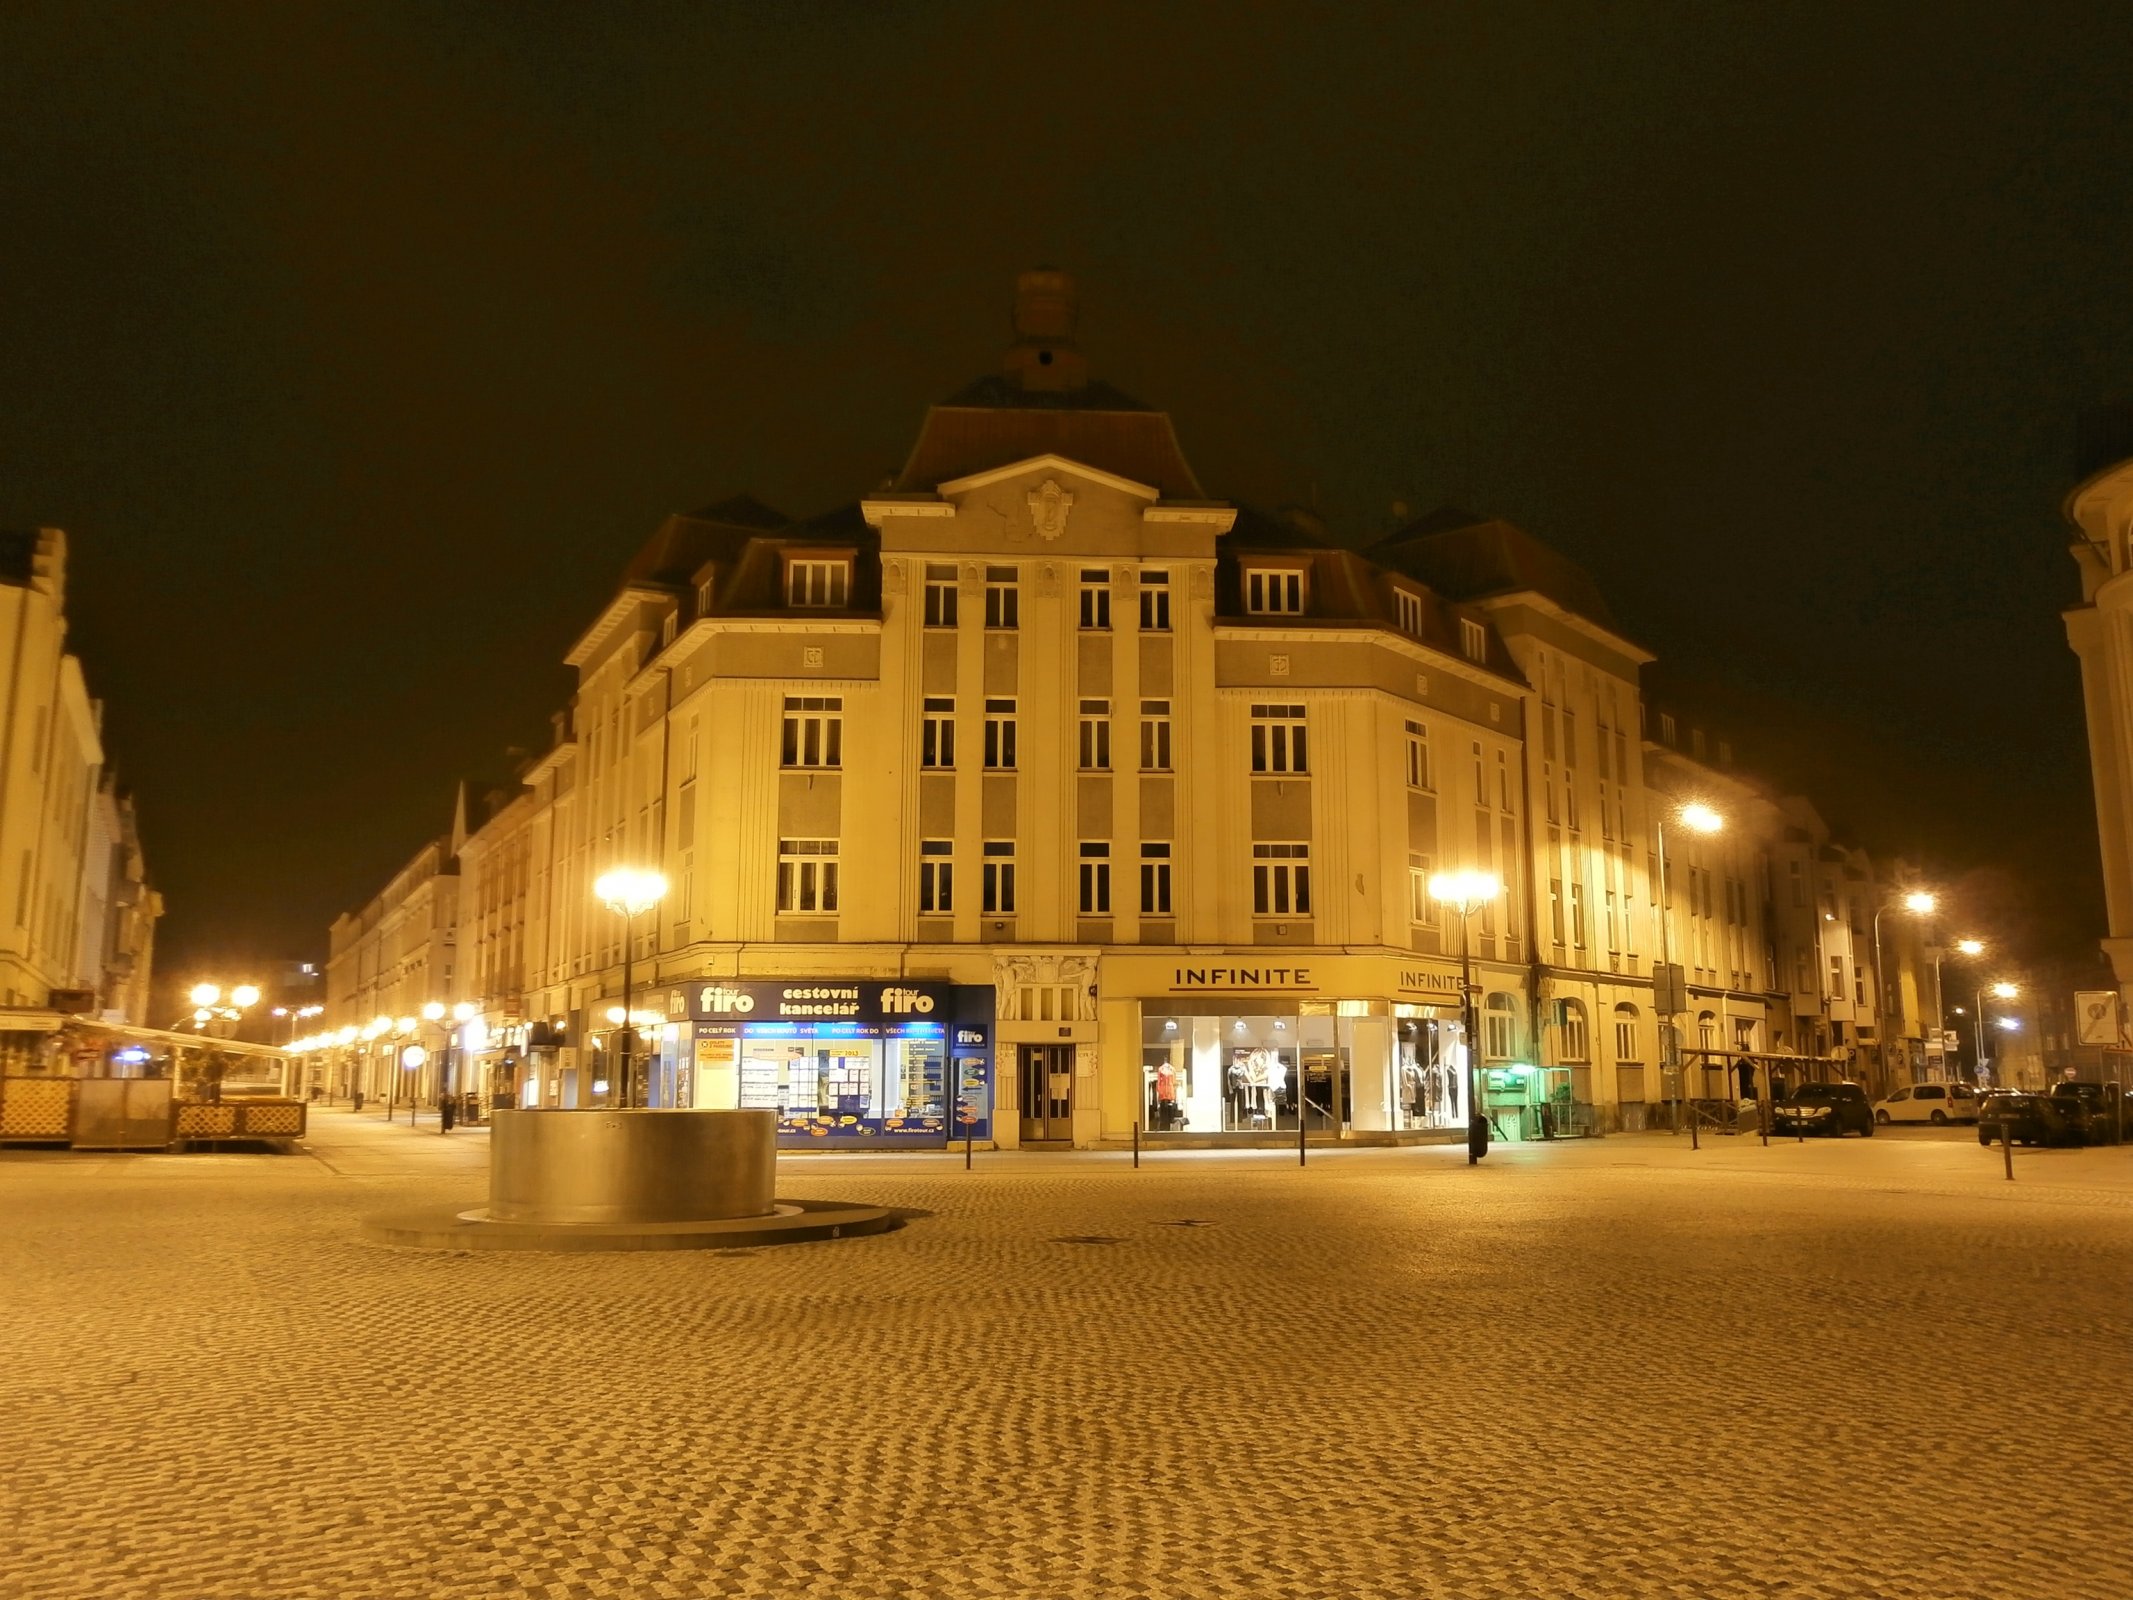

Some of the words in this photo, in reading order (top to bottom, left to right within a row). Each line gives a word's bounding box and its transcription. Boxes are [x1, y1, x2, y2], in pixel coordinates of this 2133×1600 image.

[1176, 969, 1311, 984] INFINITE
[1400, 971, 1464, 990] INFINITE
[722, 987, 740, 995] tour
[782, 986, 859, 999] cestovní
[902, 988, 920, 996] tour
[670, 989, 685, 1014] firo
[700, 987, 754, 1013] firo
[880, 988, 935, 1013] firo
[779, 1002, 860, 1015] kancelář
[957, 1030, 983, 1043] firo
